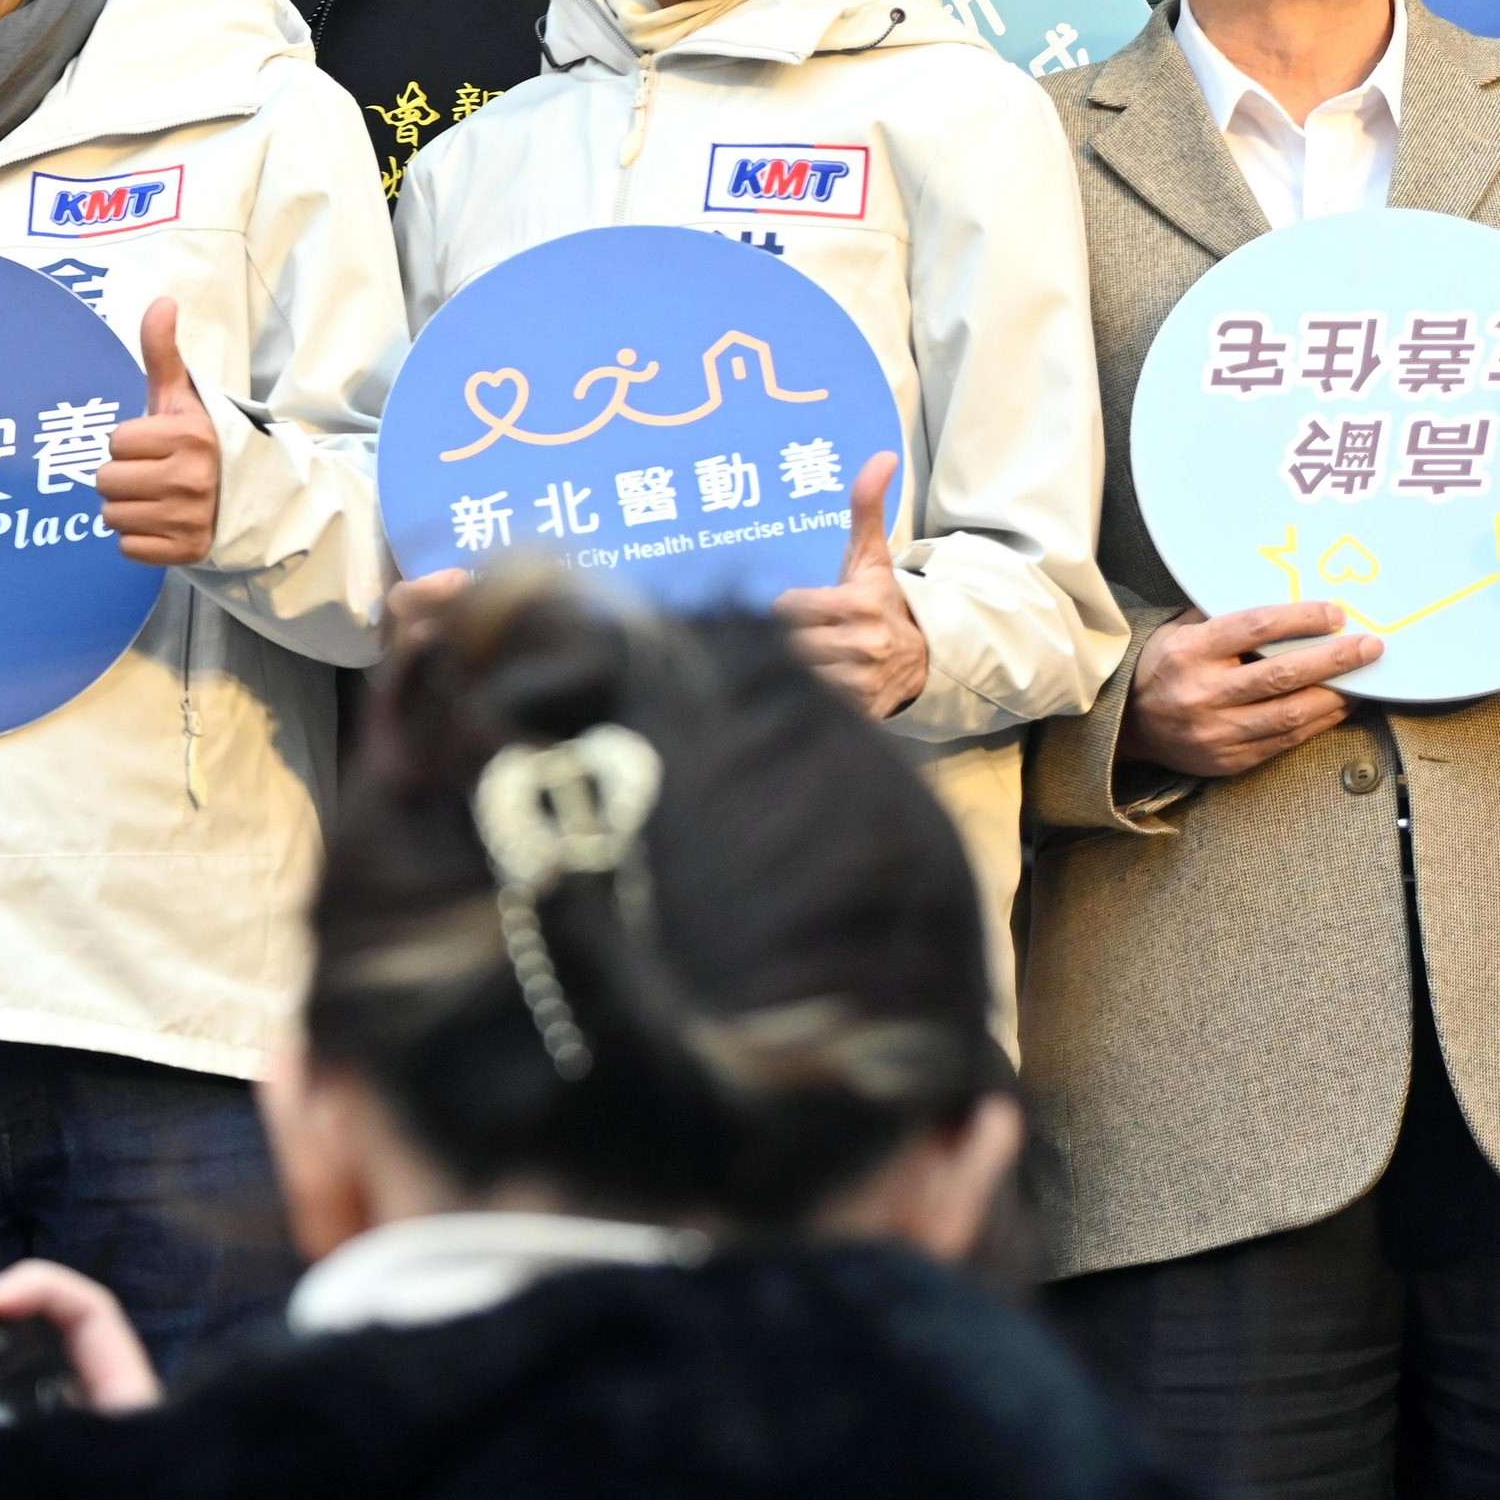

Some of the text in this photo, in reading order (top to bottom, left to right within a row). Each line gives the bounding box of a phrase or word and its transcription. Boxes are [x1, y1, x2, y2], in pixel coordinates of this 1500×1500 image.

[50, 181, 165, 226] KMT
[728, 158, 850, 203] KMT
[1211, 317, 1500, 395] 善住宅
[1287, 418, 1491, 496] 高齡
[449, 436, 846, 552] 新北醫動養
[623, 533, 695, 562] Health
[699, 521, 785, 550] Exercise
[789, 508, 853, 534] Living
